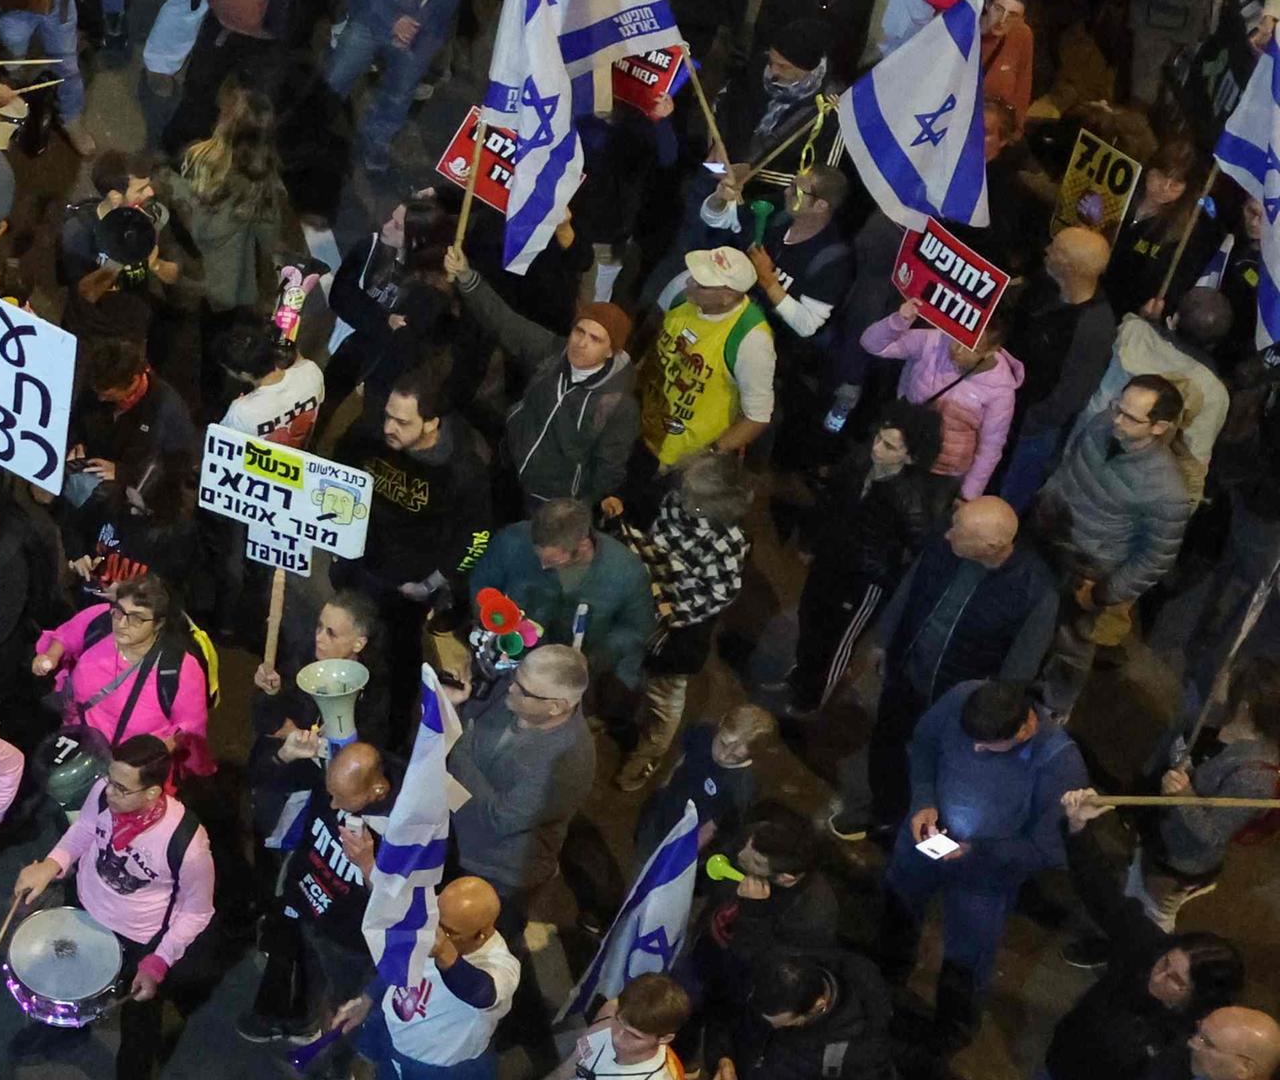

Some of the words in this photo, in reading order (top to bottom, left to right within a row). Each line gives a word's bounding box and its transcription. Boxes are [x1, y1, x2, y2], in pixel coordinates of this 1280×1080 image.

[631, 66, 660, 87] HELP
[1074, 134, 1134, 197] 7.10
[919, 230, 996, 300] לחופש
[928, 282, 983, 332] נולדו
[209, 462, 294, 511] רמאי
[343, 471, 367, 488] כתב
[200, 487, 278, 528] אמונים
[270, 529, 299, 551] די
[289, 517, 339, 548] מפר
[247, 538, 310, 572] לטרפד
[304, 872, 332, 903] FCK
